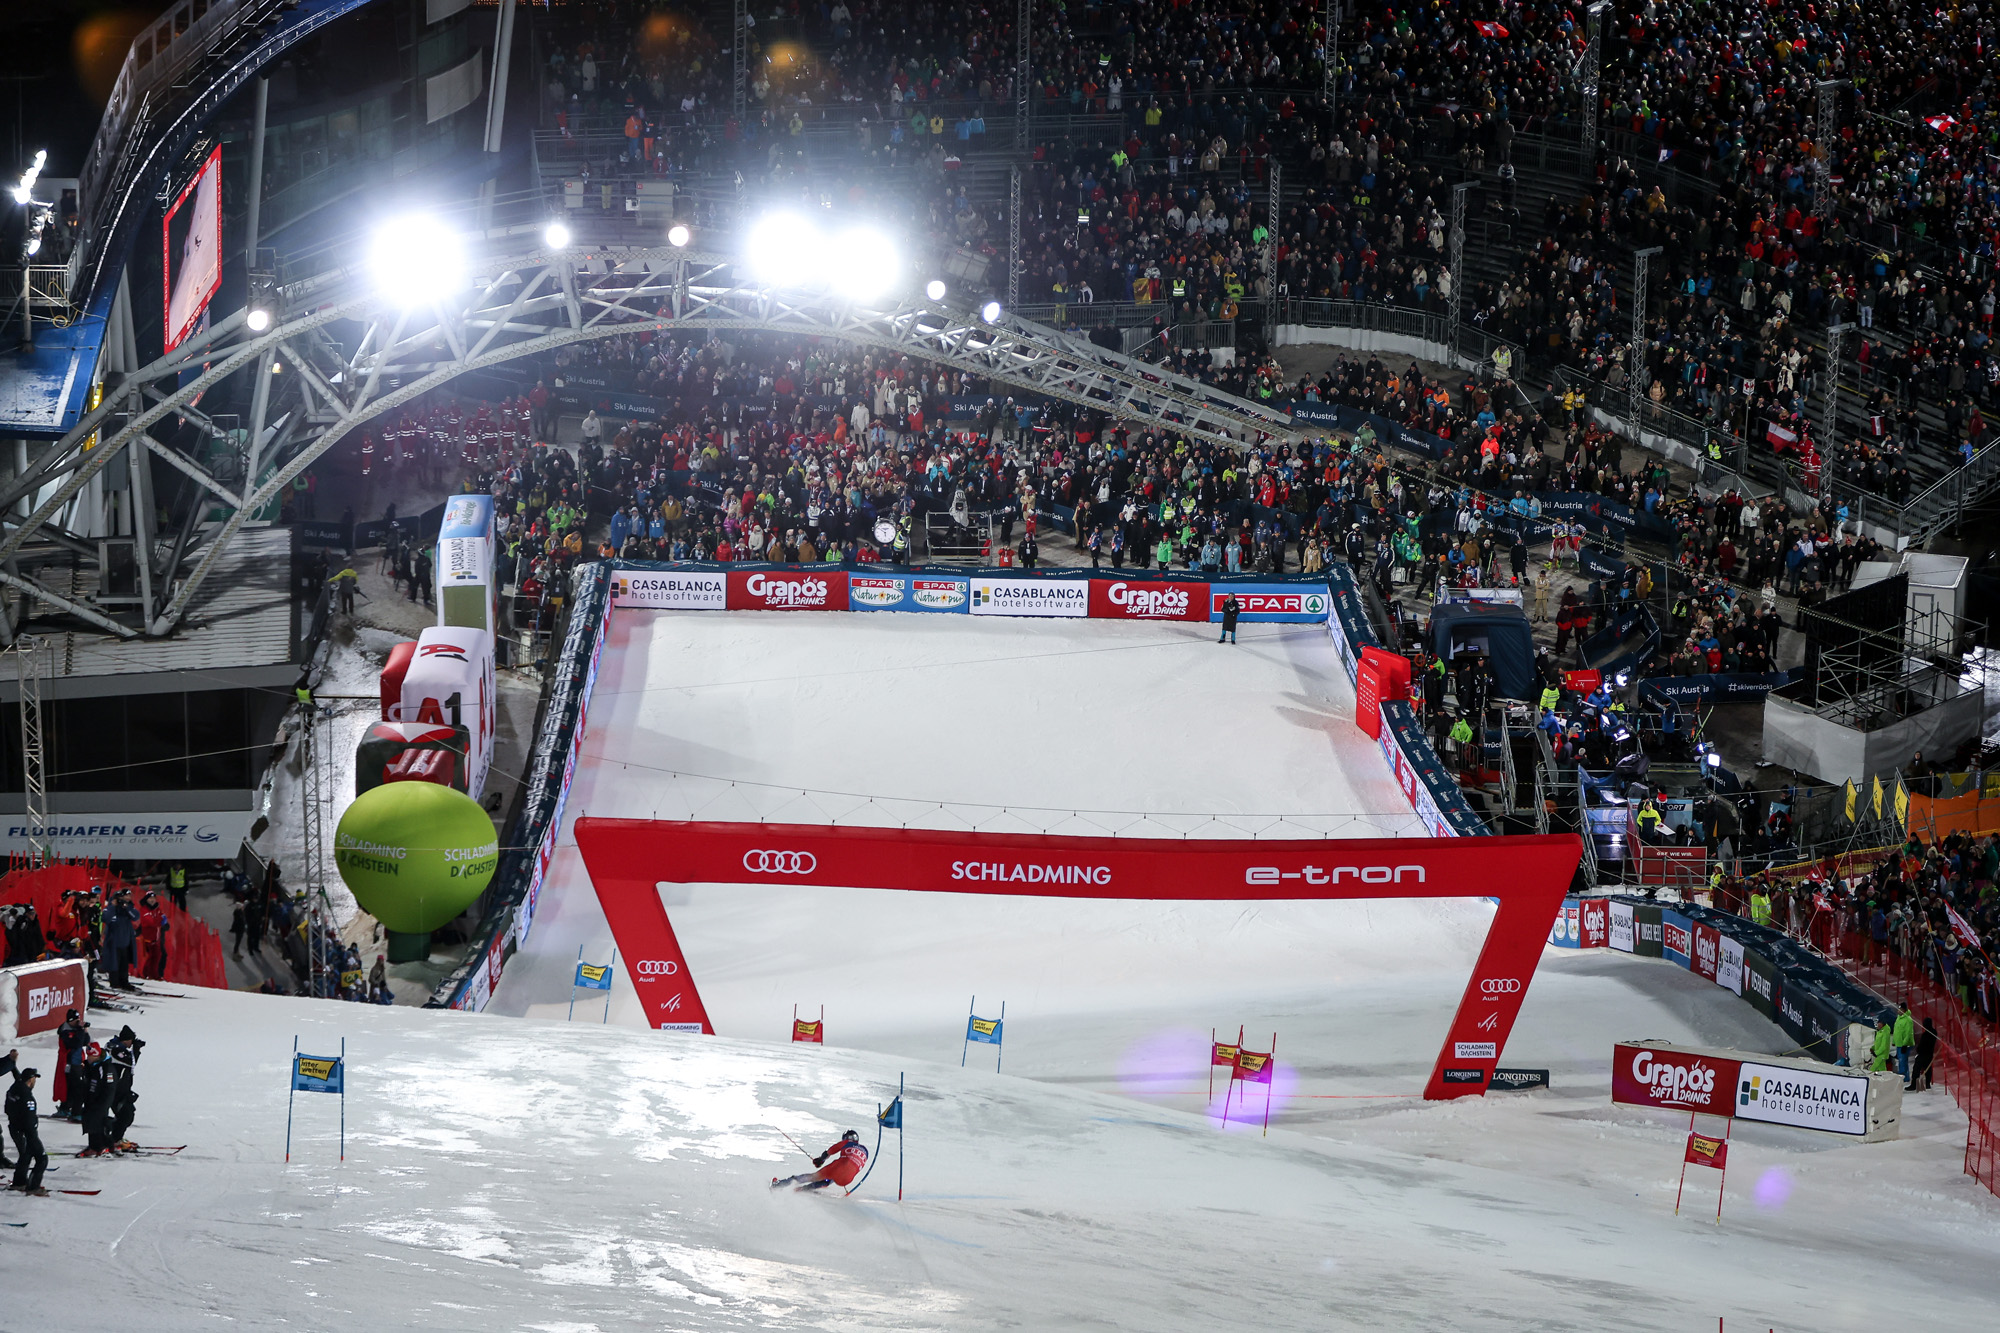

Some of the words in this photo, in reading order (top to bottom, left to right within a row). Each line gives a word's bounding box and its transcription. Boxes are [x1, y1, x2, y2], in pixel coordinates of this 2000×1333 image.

[579, 376, 606, 386] Austria
[614, 402, 626, 411] Ski
[628, 404, 656, 414] Austria
[1296, 410, 1310, 419] Ski
[1310, 412, 1338, 422] Austria
[1613, 513, 1636, 526] Austria
[632, 580, 722, 592] CASABLANCA
[631, 590, 723, 602] hotelsoftware
[994, 588, 1084, 600] CASABLANCA
[765, 596, 788, 606] SOFT
[792, 596, 826, 606] DRINKS
[994, 598, 1085, 609] hotelsoftware
[1238, 598, 1300, 610] SPAR
[1126, 605, 1148, 614] SOFT
[1154, 606, 1187, 616] DRINKS
[1666, 687, 1680, 696] Ski
[416, 692, 461, 725] A1
[8, 826, 126, 836] FLUGHAFEN
[133, 825, 188, 835] GRAZ
[340, 832, 407, 860] SCHLADMING
[951, 860, 1112, 886] SCHLADMING
[1245, 864, 1426, 886] e-tron
[1667, 928, 1686, 950] SPAR
[1492, 1072, 1541, 1082] LONGINES
[1650, 1086, 1672, 1098] SOFT
[1678, 1091, 1711, 1105] DRINKS
[1764, 1079, 1860, 1106] CASABLANCA
[1762, 1096, 1860, 1121] hotelsoftware
